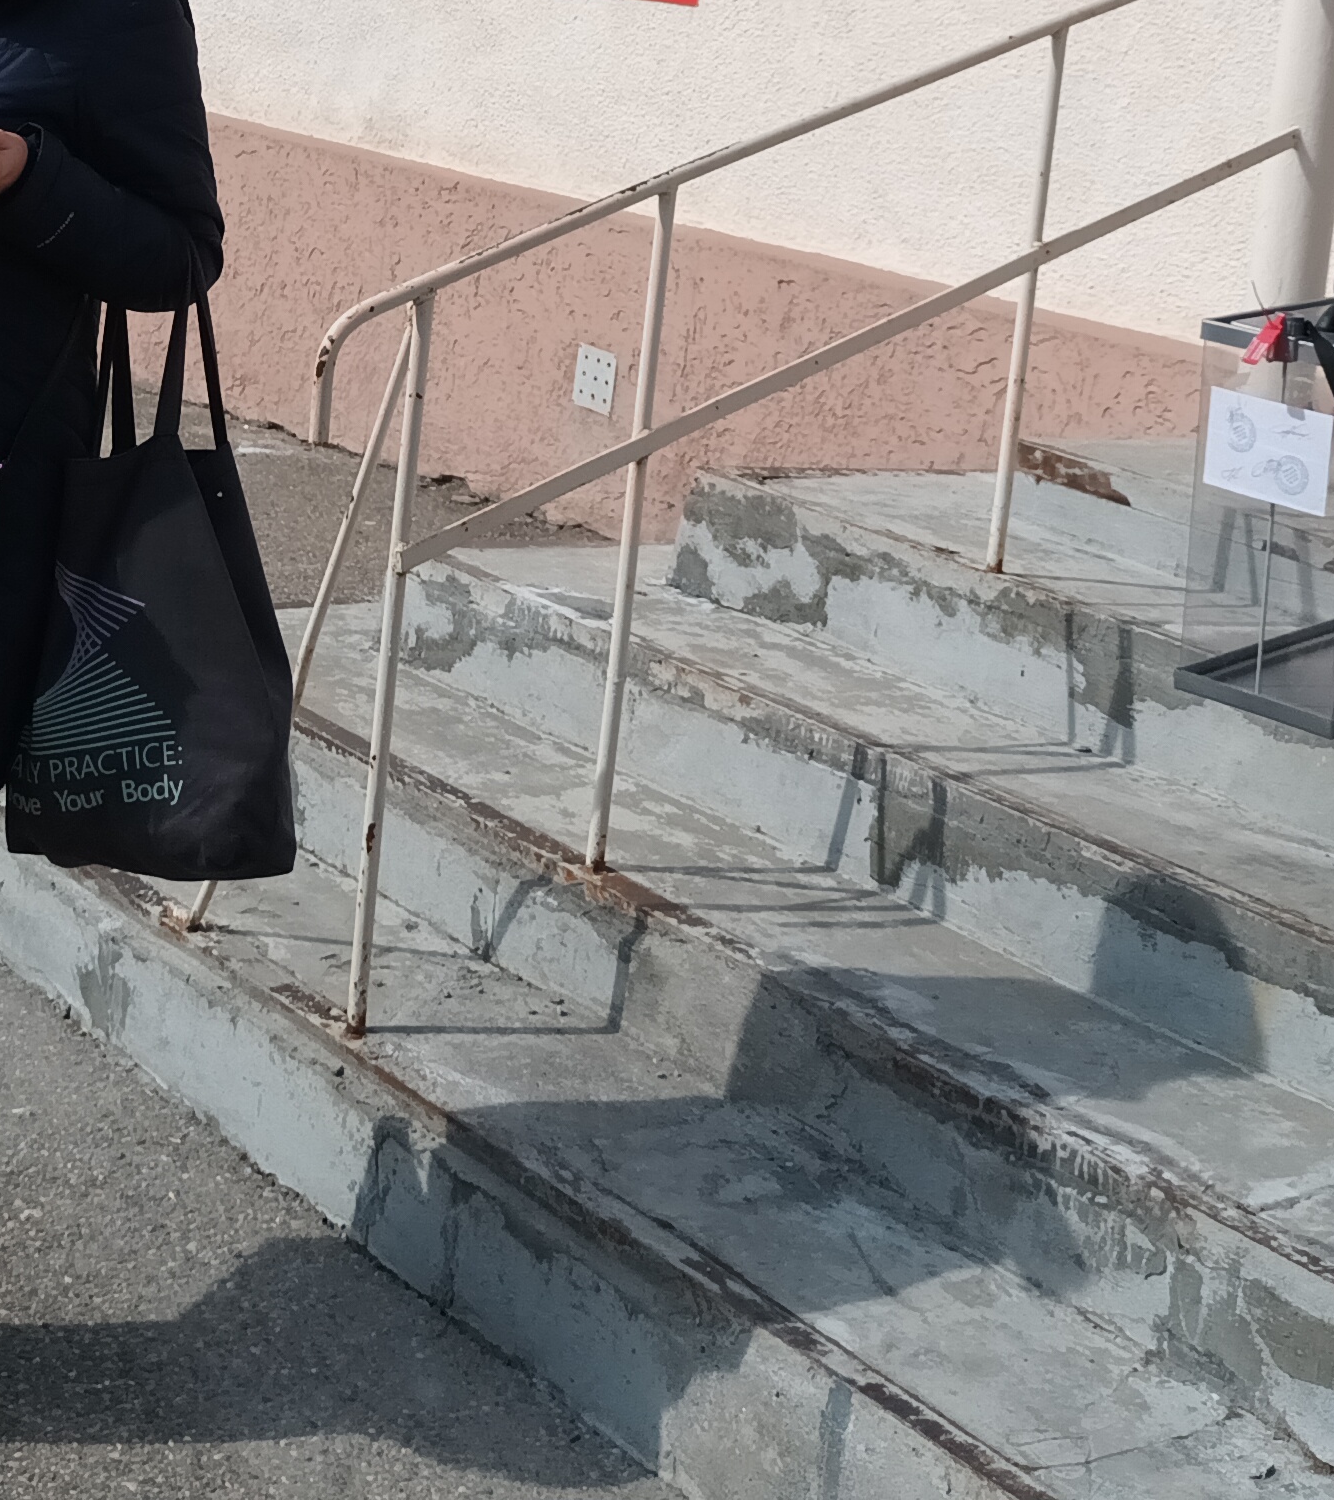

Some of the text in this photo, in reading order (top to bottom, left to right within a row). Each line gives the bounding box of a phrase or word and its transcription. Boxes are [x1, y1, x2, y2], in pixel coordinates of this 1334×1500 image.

[49, 741, 183, 783] PRACTICE:
[53, 788, 105, 813] Your
[121, 773, 184, 806] Body
